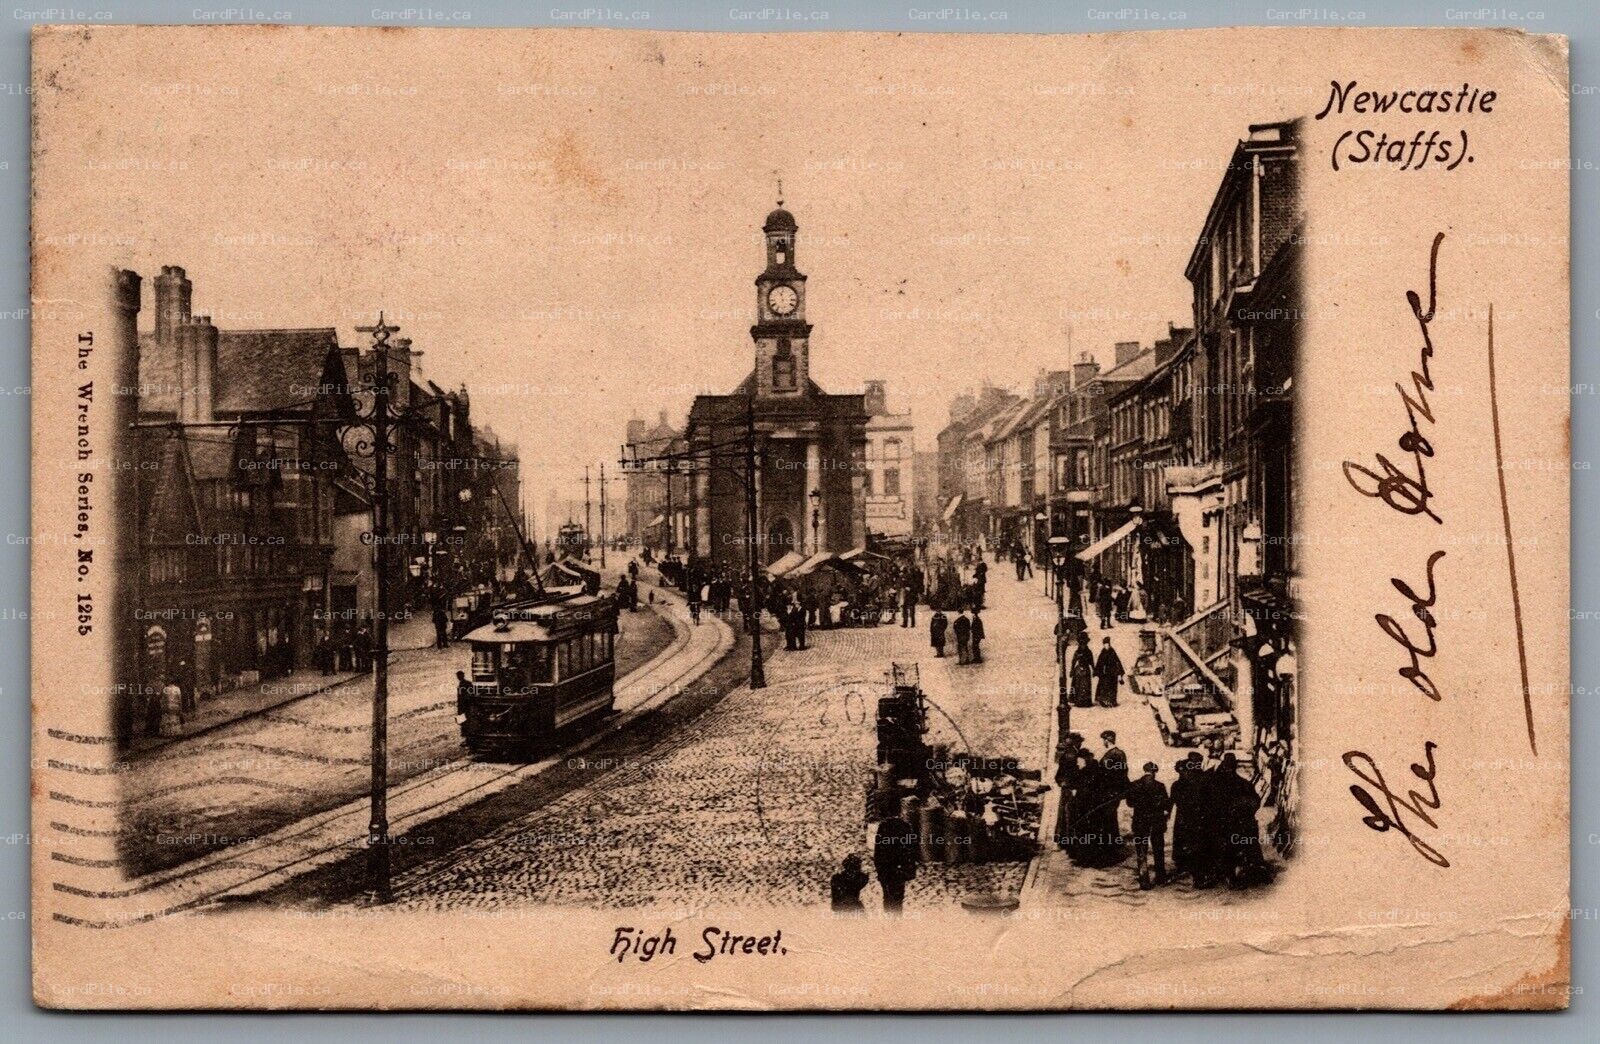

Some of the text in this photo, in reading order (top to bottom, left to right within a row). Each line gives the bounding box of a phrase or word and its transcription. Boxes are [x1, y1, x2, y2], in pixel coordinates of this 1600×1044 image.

[1332, 130, 1474, 172] (Staffs).
[73, 331, 93, 637] The Wrench Series, No. 1255
[1374, 550, 1447, 703] old
[1341, 740, 1451, 868] The
[609, 926, 788, 964] High Street.
